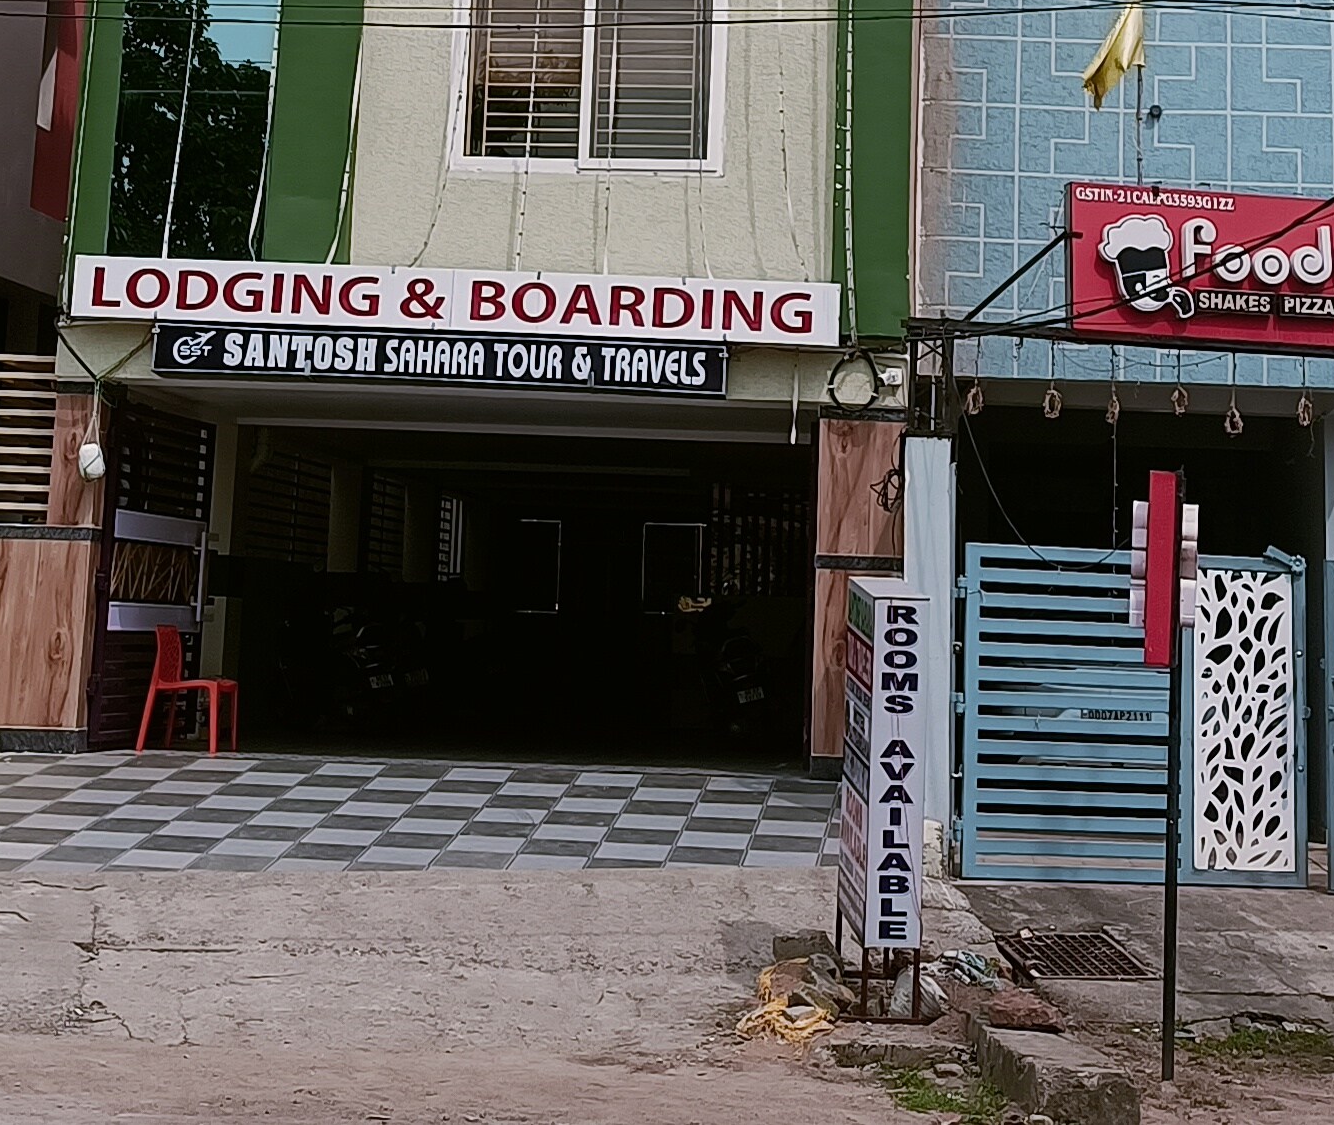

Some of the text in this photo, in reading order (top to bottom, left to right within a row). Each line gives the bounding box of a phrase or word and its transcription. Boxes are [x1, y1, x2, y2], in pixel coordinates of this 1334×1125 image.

[90, 266, 815, 335] LODGING & BOARDING
[1198, 292, 1271, 312] SHAKES
[223, 332, 706, 386] SANTOSH SAHARA TOUR & TRAVELS
[877, 605, 919, 940] ROOMS AVAILABLE
